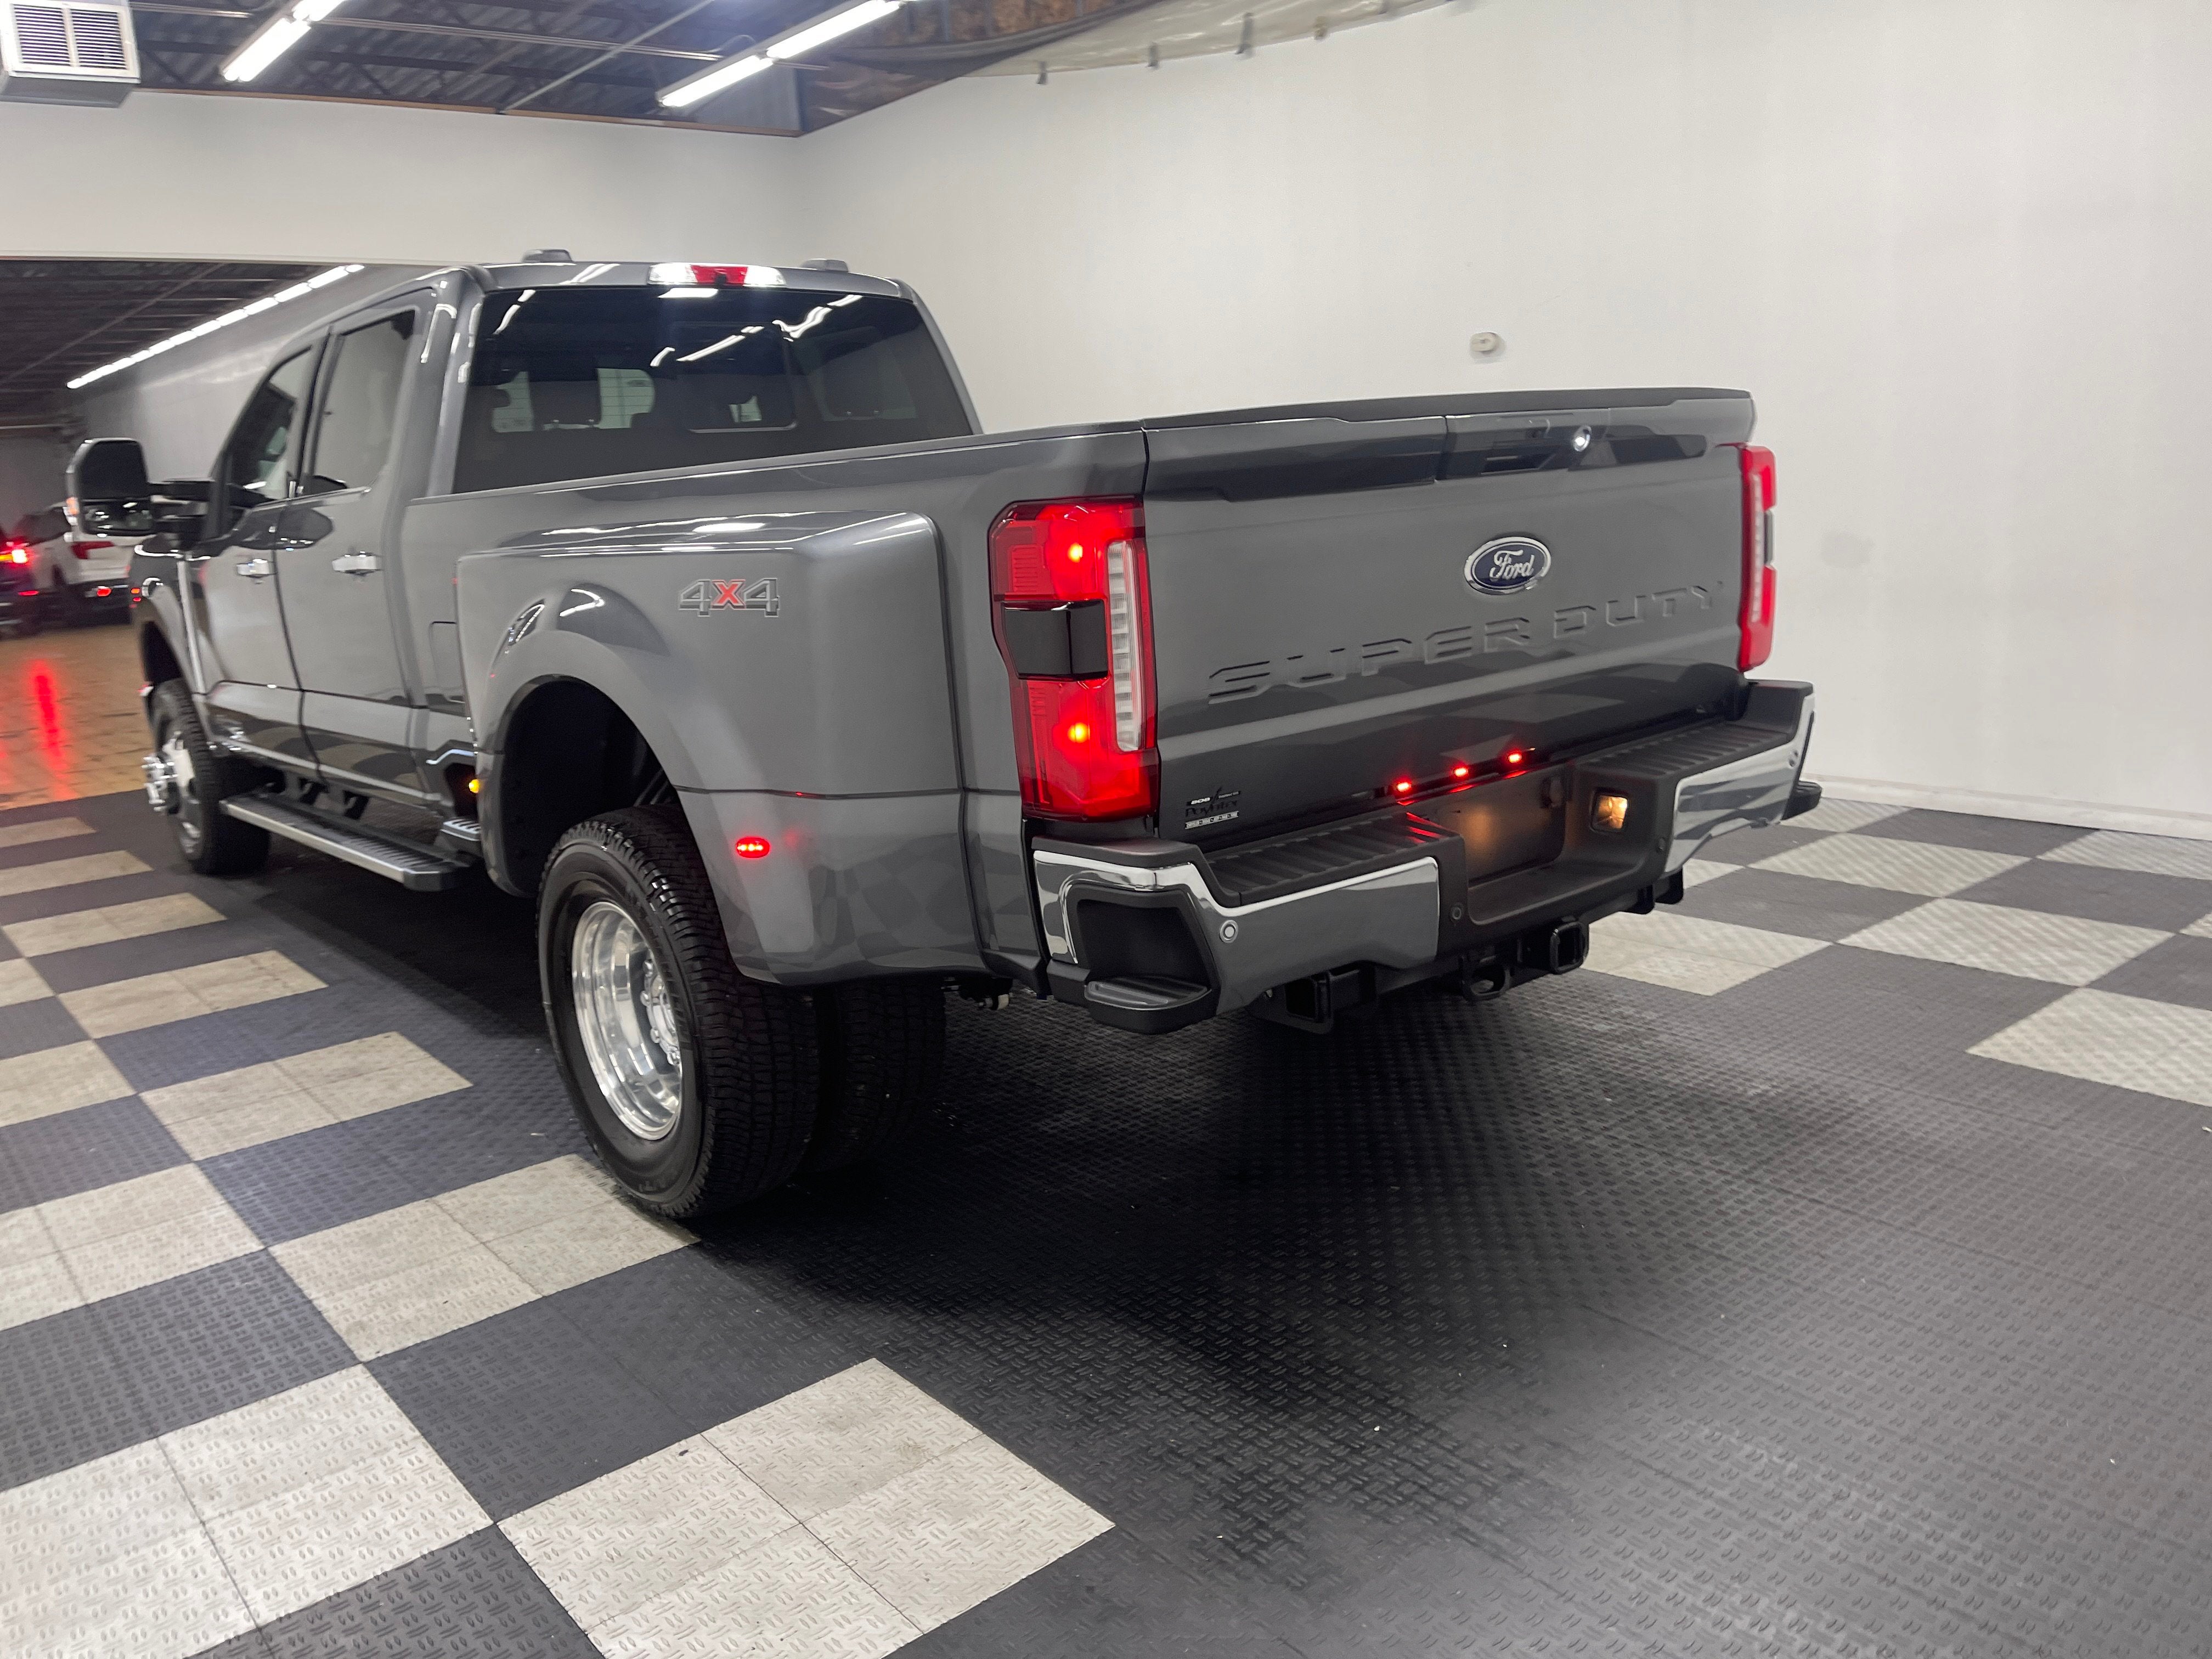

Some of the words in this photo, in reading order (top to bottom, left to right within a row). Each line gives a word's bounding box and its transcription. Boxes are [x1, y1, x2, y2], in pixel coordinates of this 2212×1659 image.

[1489, 549, 1535, 582] Ford
[1208, 616, 1531, 705] SUPER
[1553, 580, 1724, 640] DUTY
